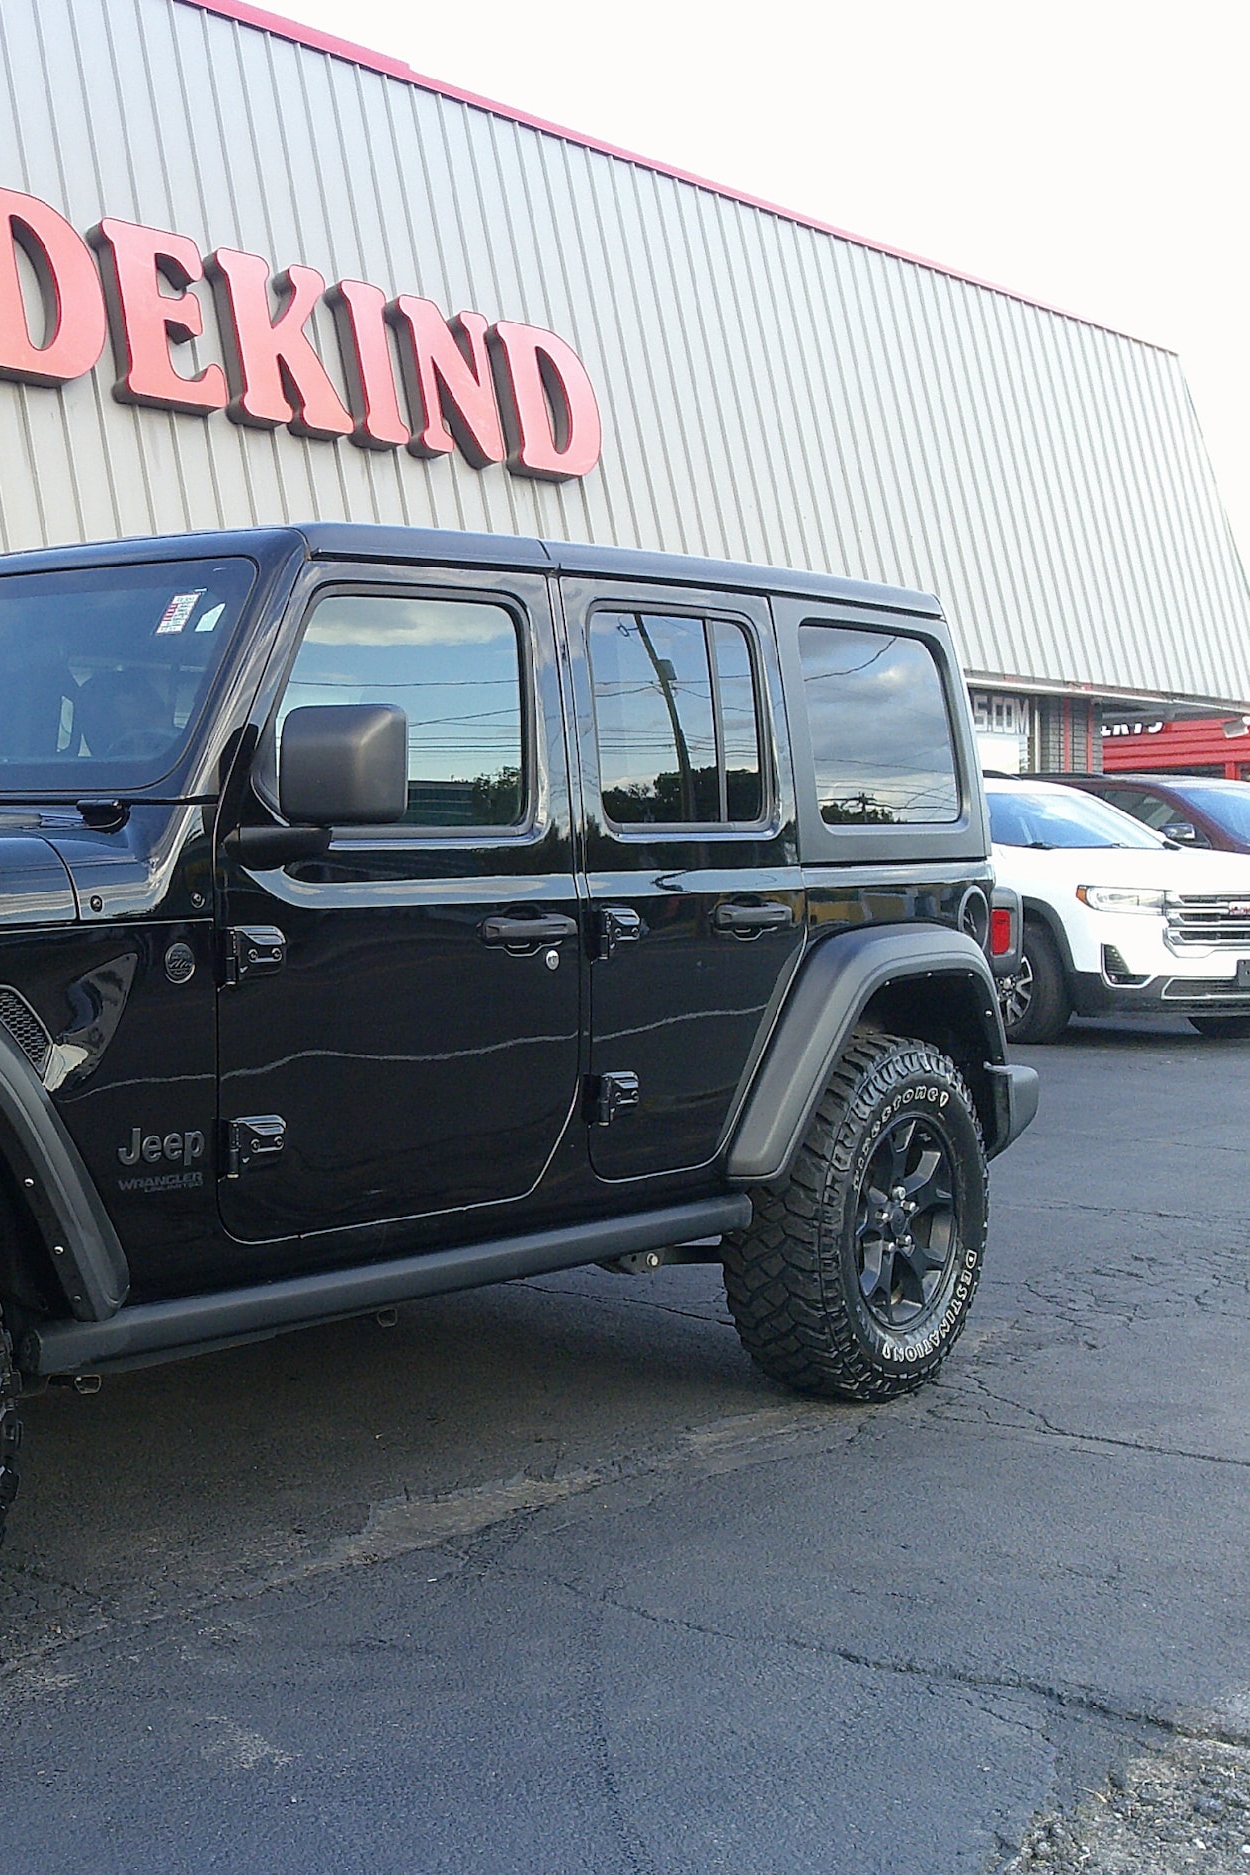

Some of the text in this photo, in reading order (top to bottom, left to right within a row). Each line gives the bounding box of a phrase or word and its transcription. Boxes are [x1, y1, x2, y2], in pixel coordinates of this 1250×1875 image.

[118, 1127, 205, 1166] Jeep
[118, 1171, 204, 1191] WRANGLER
[893, 1249, 978, 1363] DESTINATION
